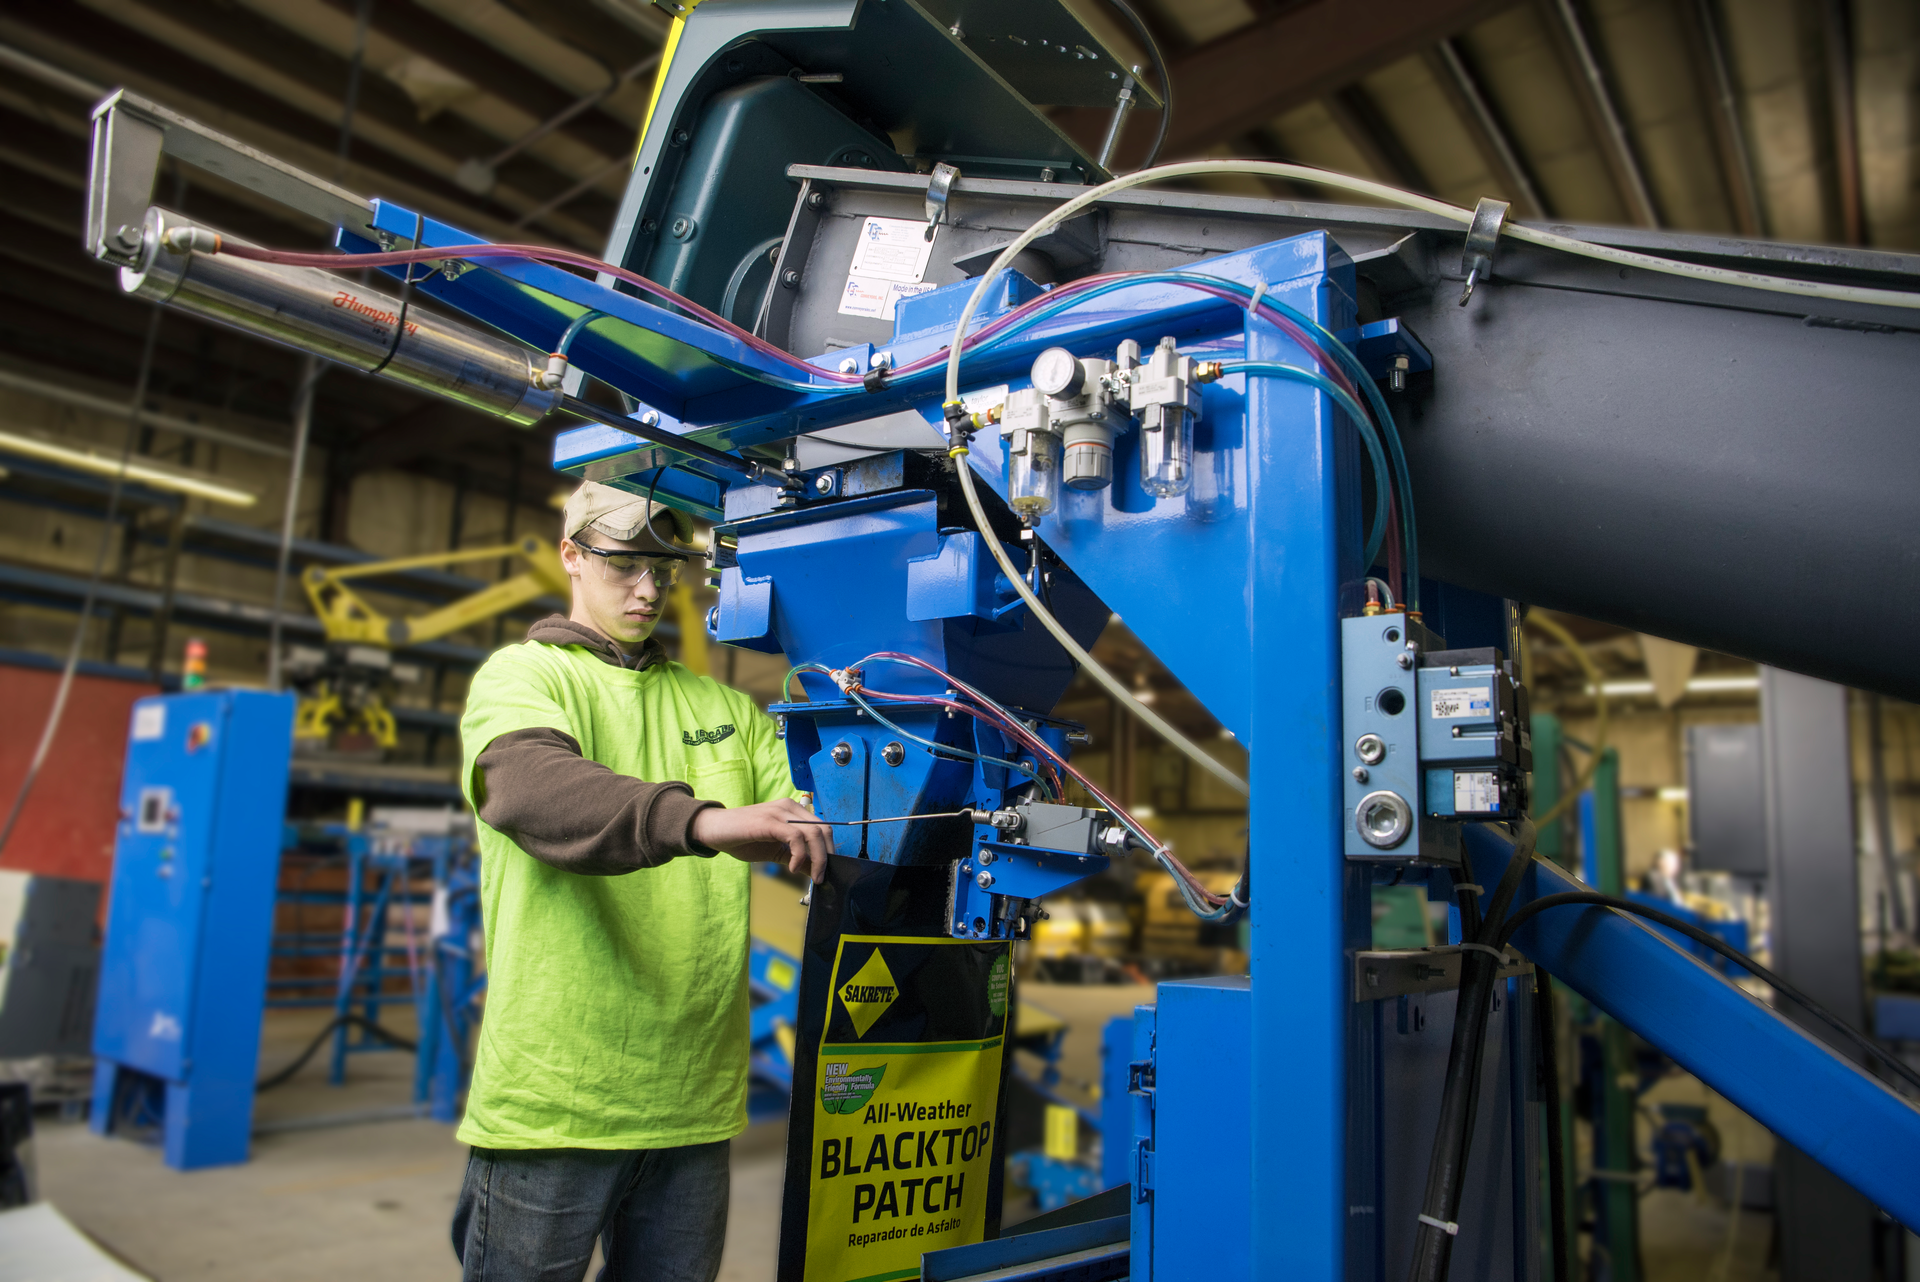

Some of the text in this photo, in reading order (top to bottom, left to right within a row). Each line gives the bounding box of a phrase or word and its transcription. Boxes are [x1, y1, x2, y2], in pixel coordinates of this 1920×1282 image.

[893, 284, 907, 292] Made
[913, 286, 922, 294] the
[332, 291, 420, 336] Humphrey
[844, 984, 894, 1003] SAKRETE
[825, 1075, 872, 1083] Environmentally
[826, 1063, 848, 1075] NEW
[824, 1083, 848, 1092] Friendly
[863, 1100, 971, 1124] All-Weather
[820, 1121, 990, 1179] BLACKTOP
[852, 1172, 965, 1223] PATCH
[848, 1217, 961, 1247] Reparador de Asfalto
